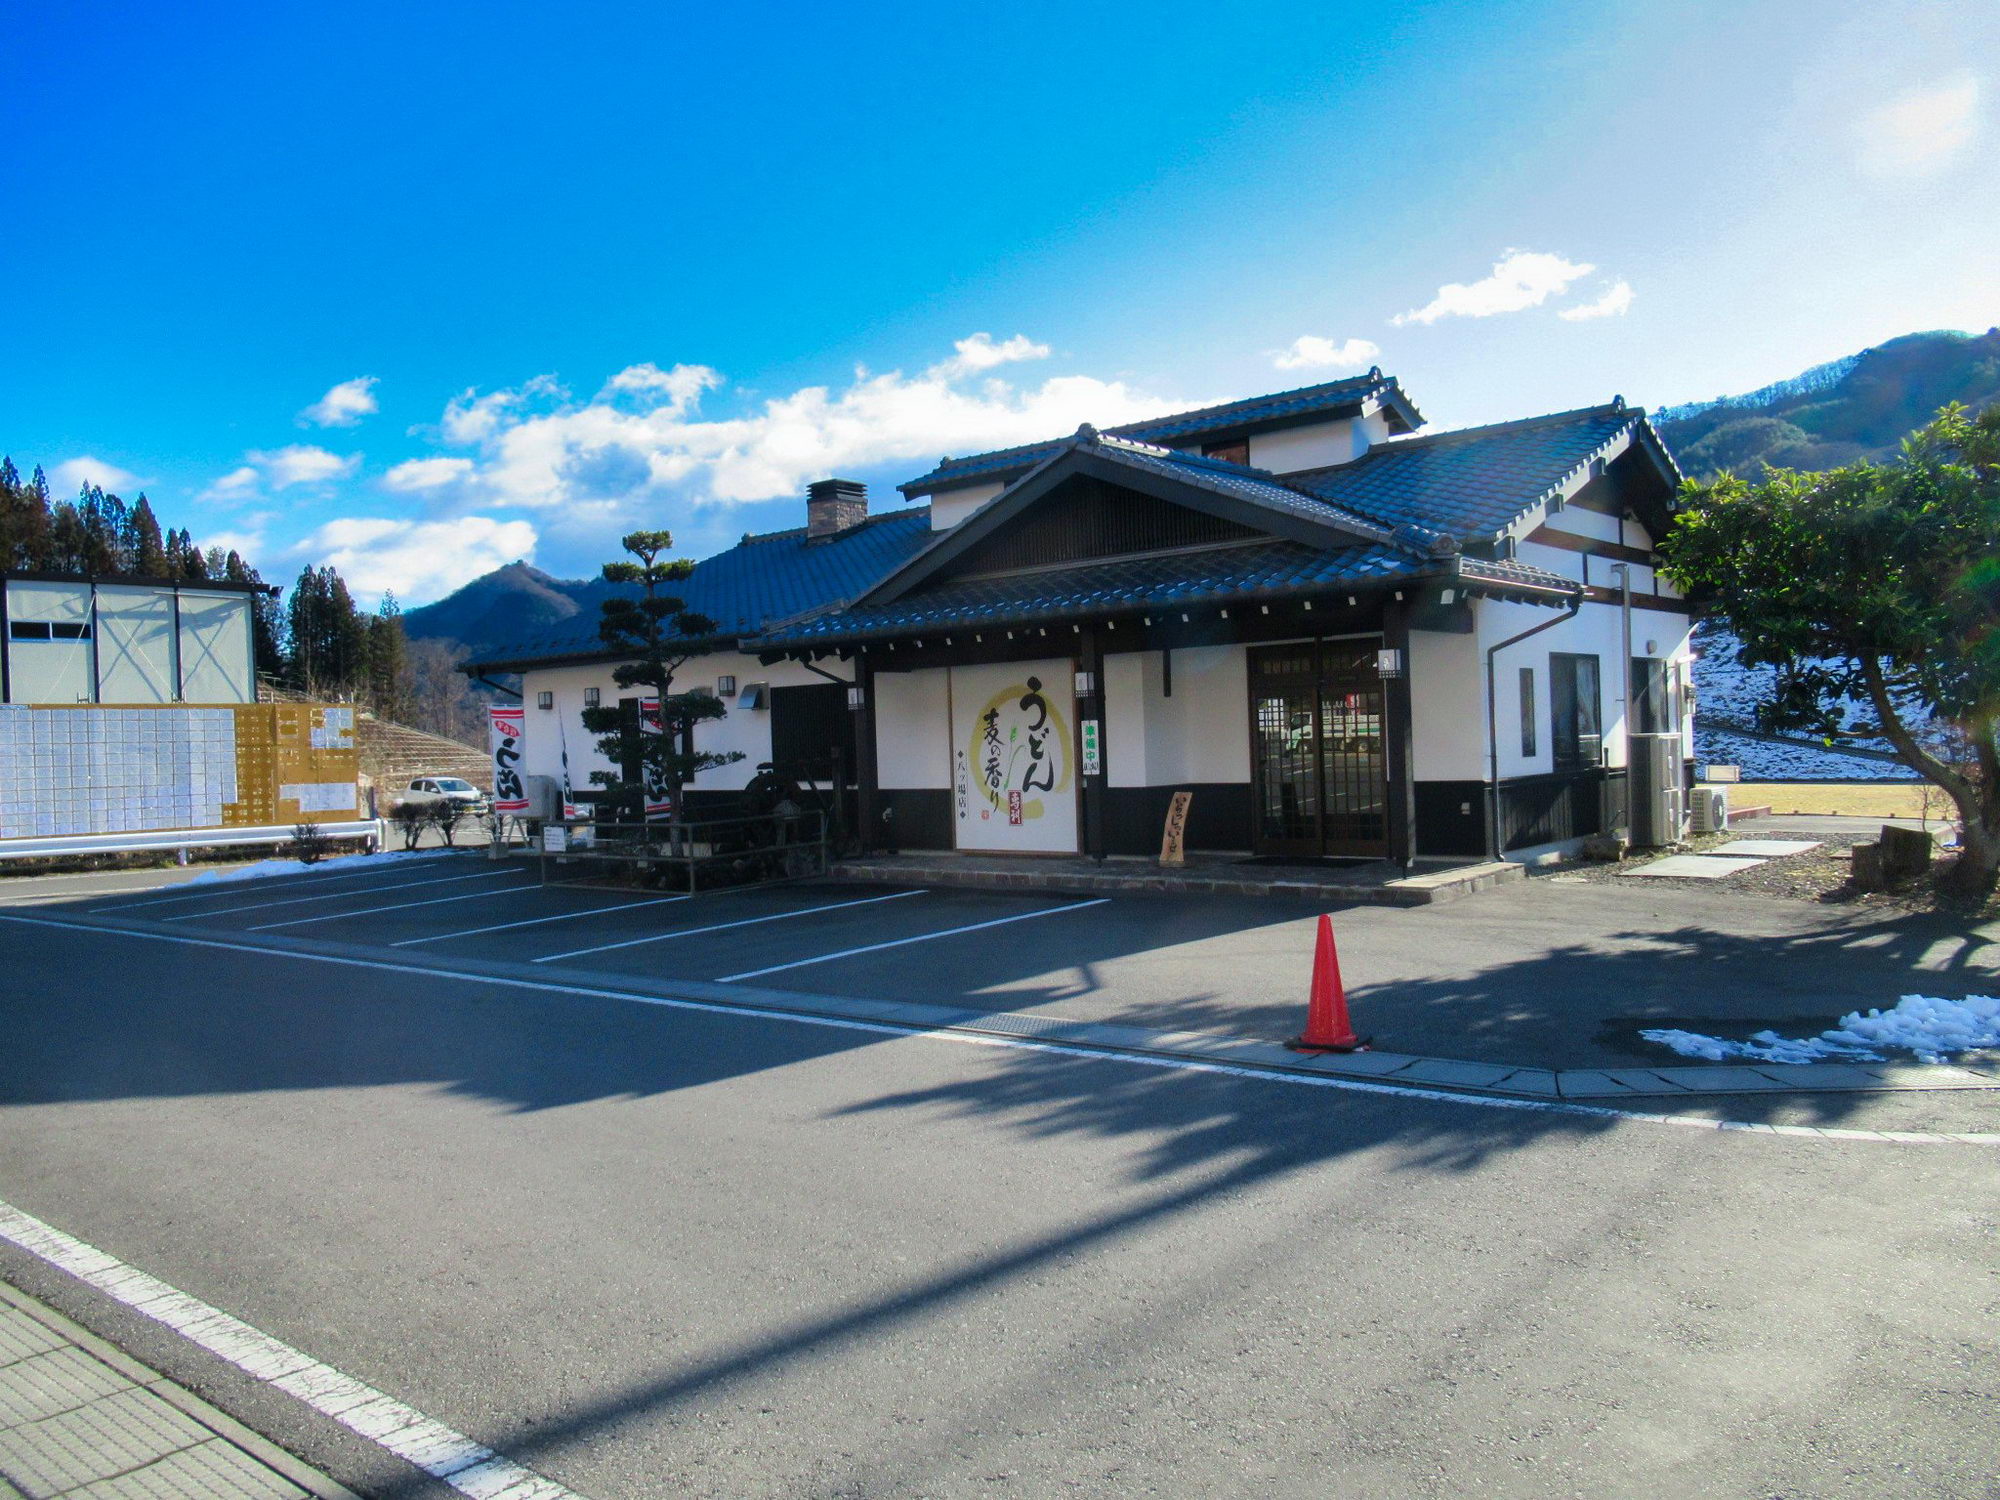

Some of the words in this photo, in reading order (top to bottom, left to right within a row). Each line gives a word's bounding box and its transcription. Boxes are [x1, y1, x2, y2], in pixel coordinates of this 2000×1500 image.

[983, 708, 1006, 812] 麦の香り
[1020, 676, 1054, 792] うどん
